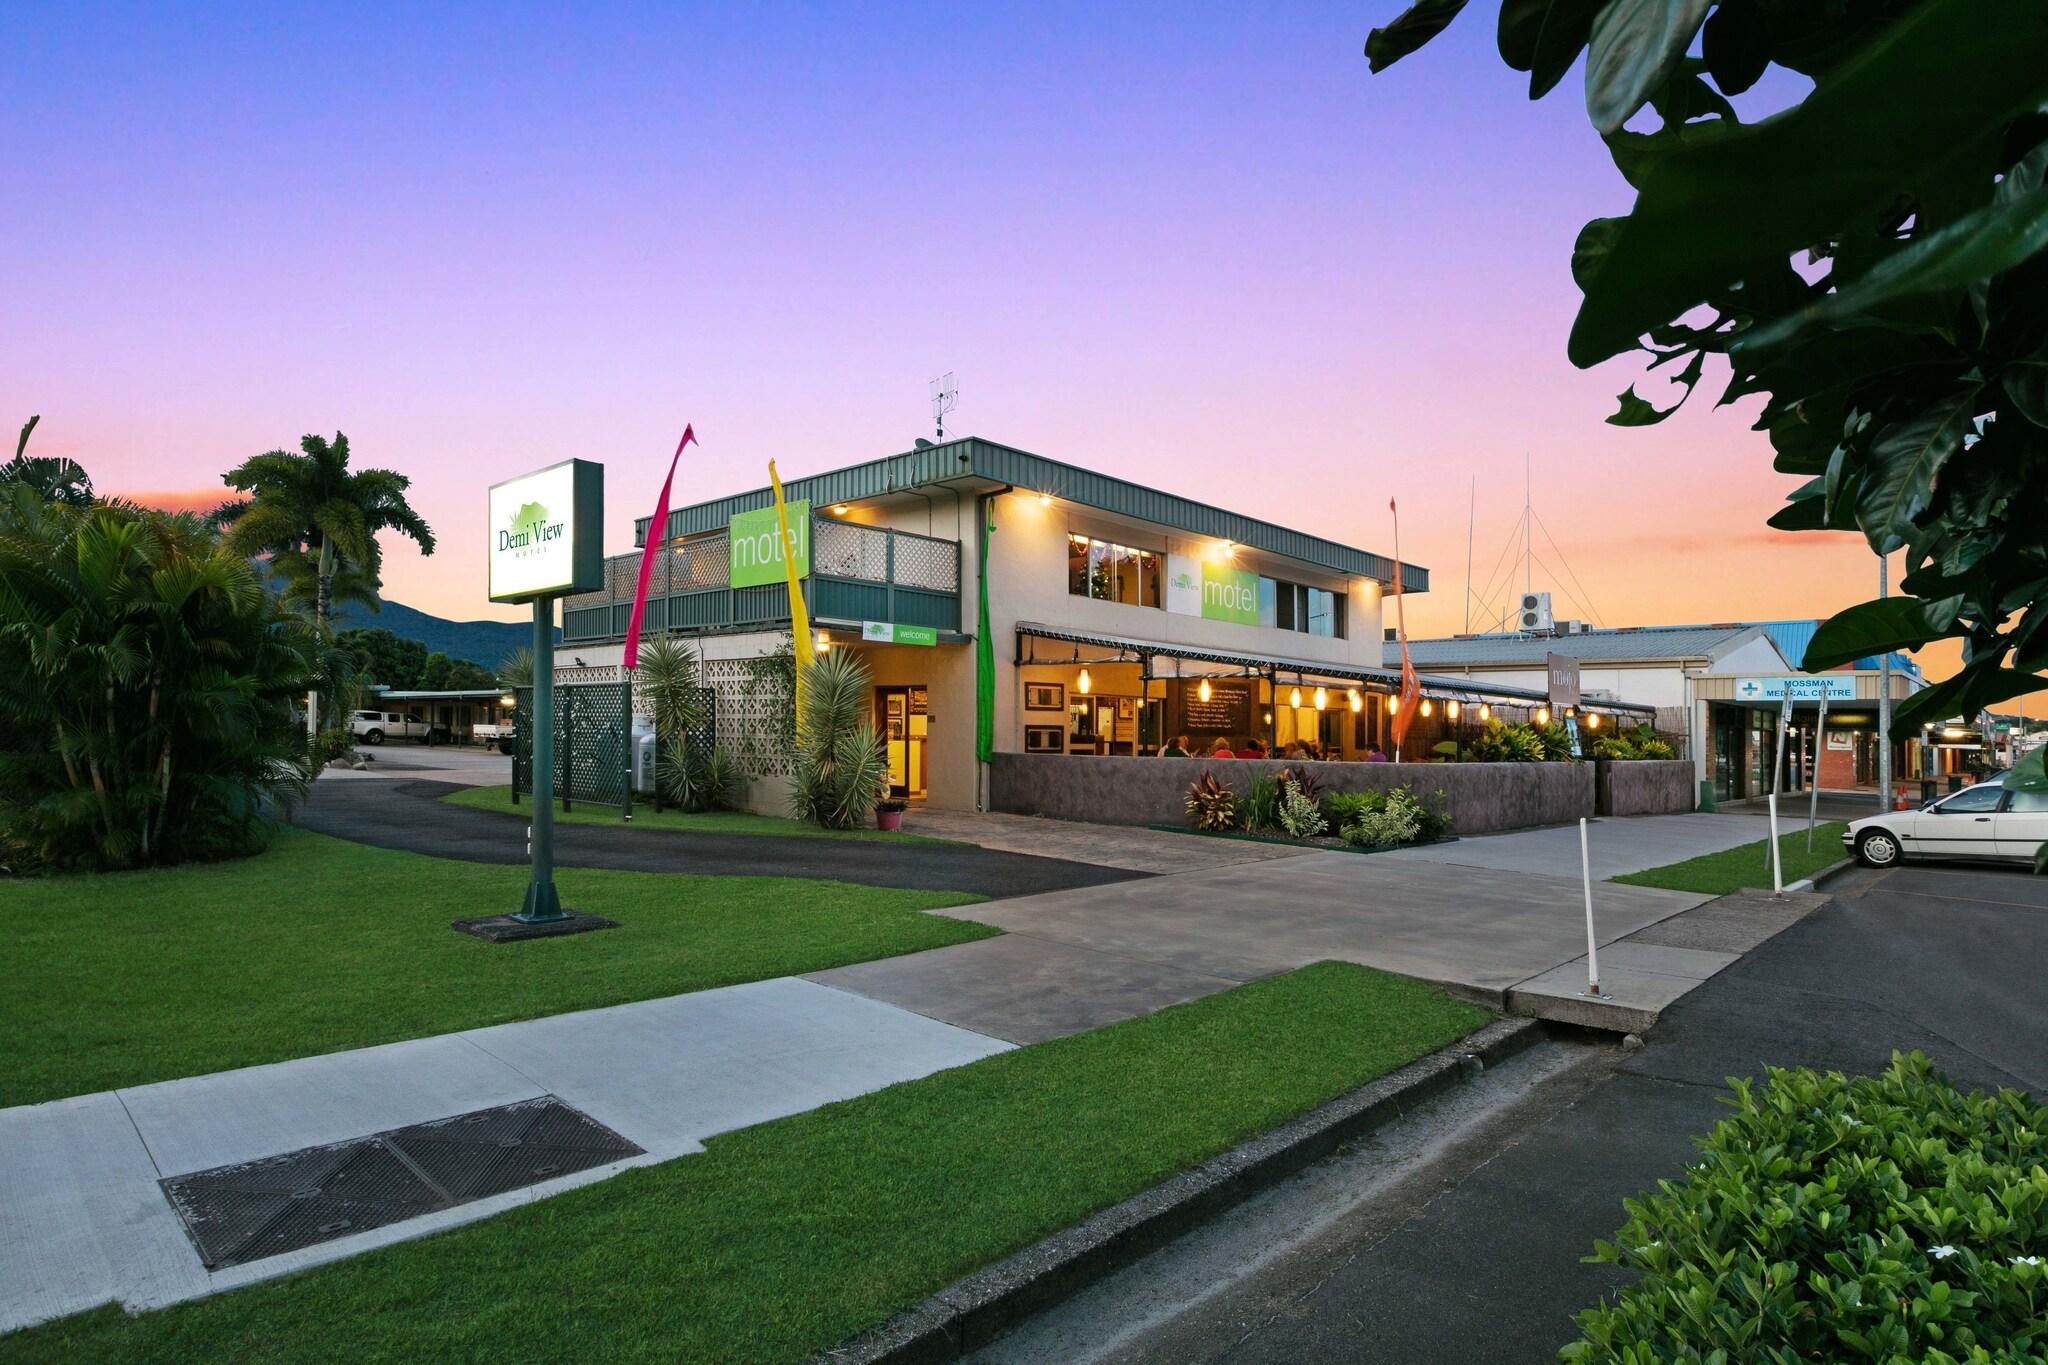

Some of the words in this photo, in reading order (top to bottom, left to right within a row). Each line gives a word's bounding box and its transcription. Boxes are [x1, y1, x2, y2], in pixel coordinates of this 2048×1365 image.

[499, 524, 529, 552] Demi
[533, 520, 564, 543] View
[734, 515, 804, 568] motel
[1204, 579, 1257, 613] motel
[900, 631, 930, 641] welcome
[1553, 664, 1577, 697] mojo
